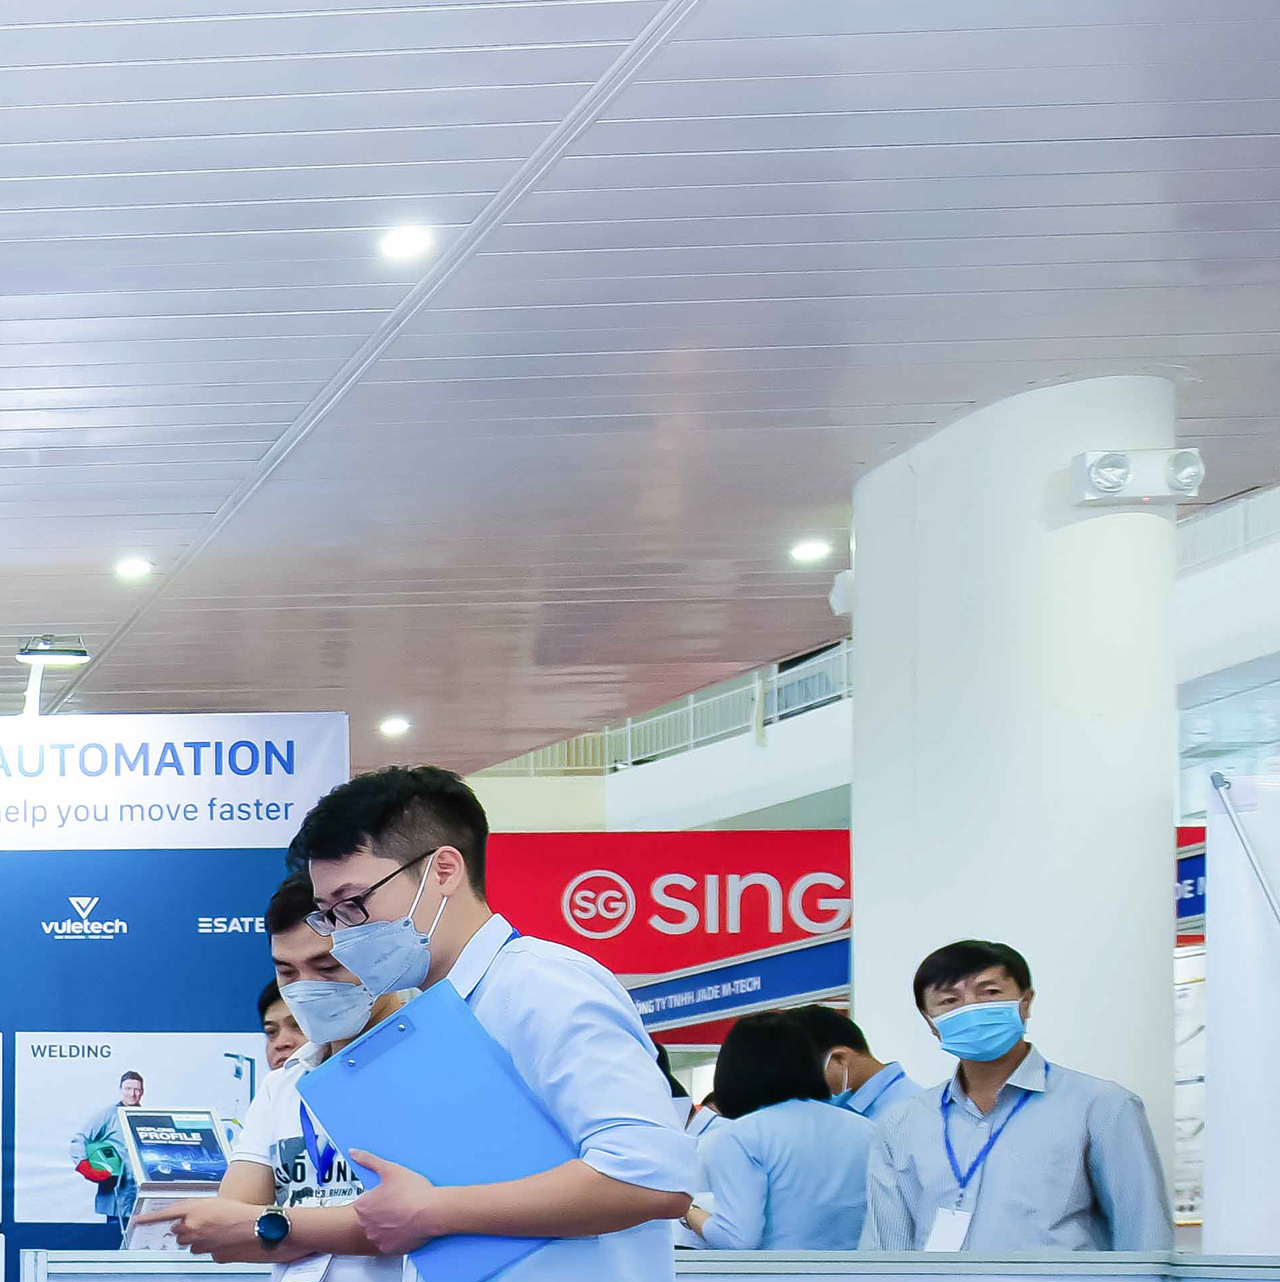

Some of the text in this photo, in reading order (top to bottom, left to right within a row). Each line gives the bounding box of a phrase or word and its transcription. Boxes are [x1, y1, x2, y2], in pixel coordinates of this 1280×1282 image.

[56, 803, 109, 828] you
[119, 802, 198, 821] move
[207, 798, 295, 821] faster
[573, 889, 627, 919] SG
[41, 917, 128, 934] vuletech
[634, 999, 655, 1014] ÔNG
[722, 976, 761, 997] M-TECH
[30, 1044, 112, 1058] WELDING
[138, 1132, 203, 1141] PROFILE
